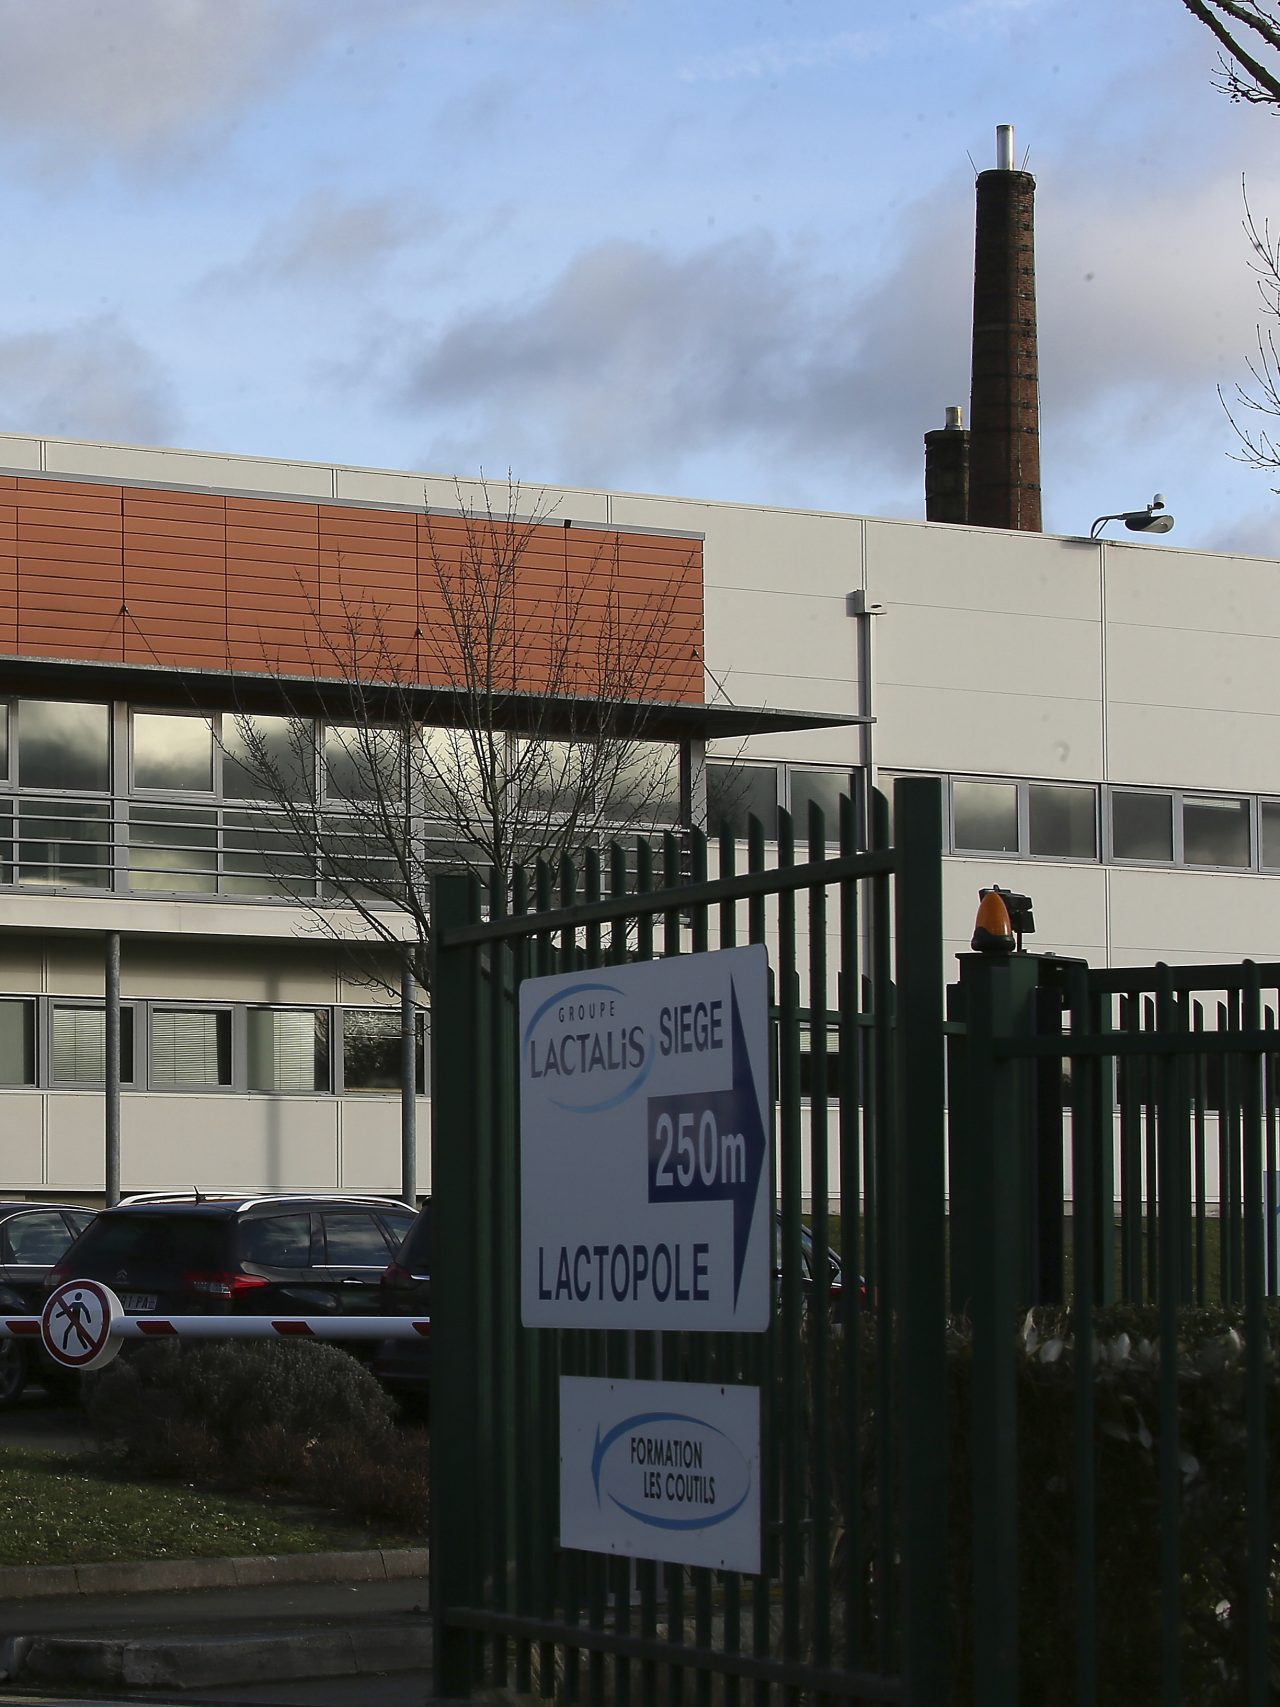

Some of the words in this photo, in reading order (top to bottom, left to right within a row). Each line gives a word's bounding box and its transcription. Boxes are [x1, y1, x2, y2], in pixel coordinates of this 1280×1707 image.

[558, 1000, 616, 1023] GROUPE
[659, 1000, 724, 1056] SIEGE
[655, 1109, 746, 1187] 250m
[538, 1243, 710, 1302] LACTOPOLE
[631, 1437, 702, 1469] FORMATION
[644, 1471, 662, 1499] LES
[665, 1472, 716, 1505] COUTILS
